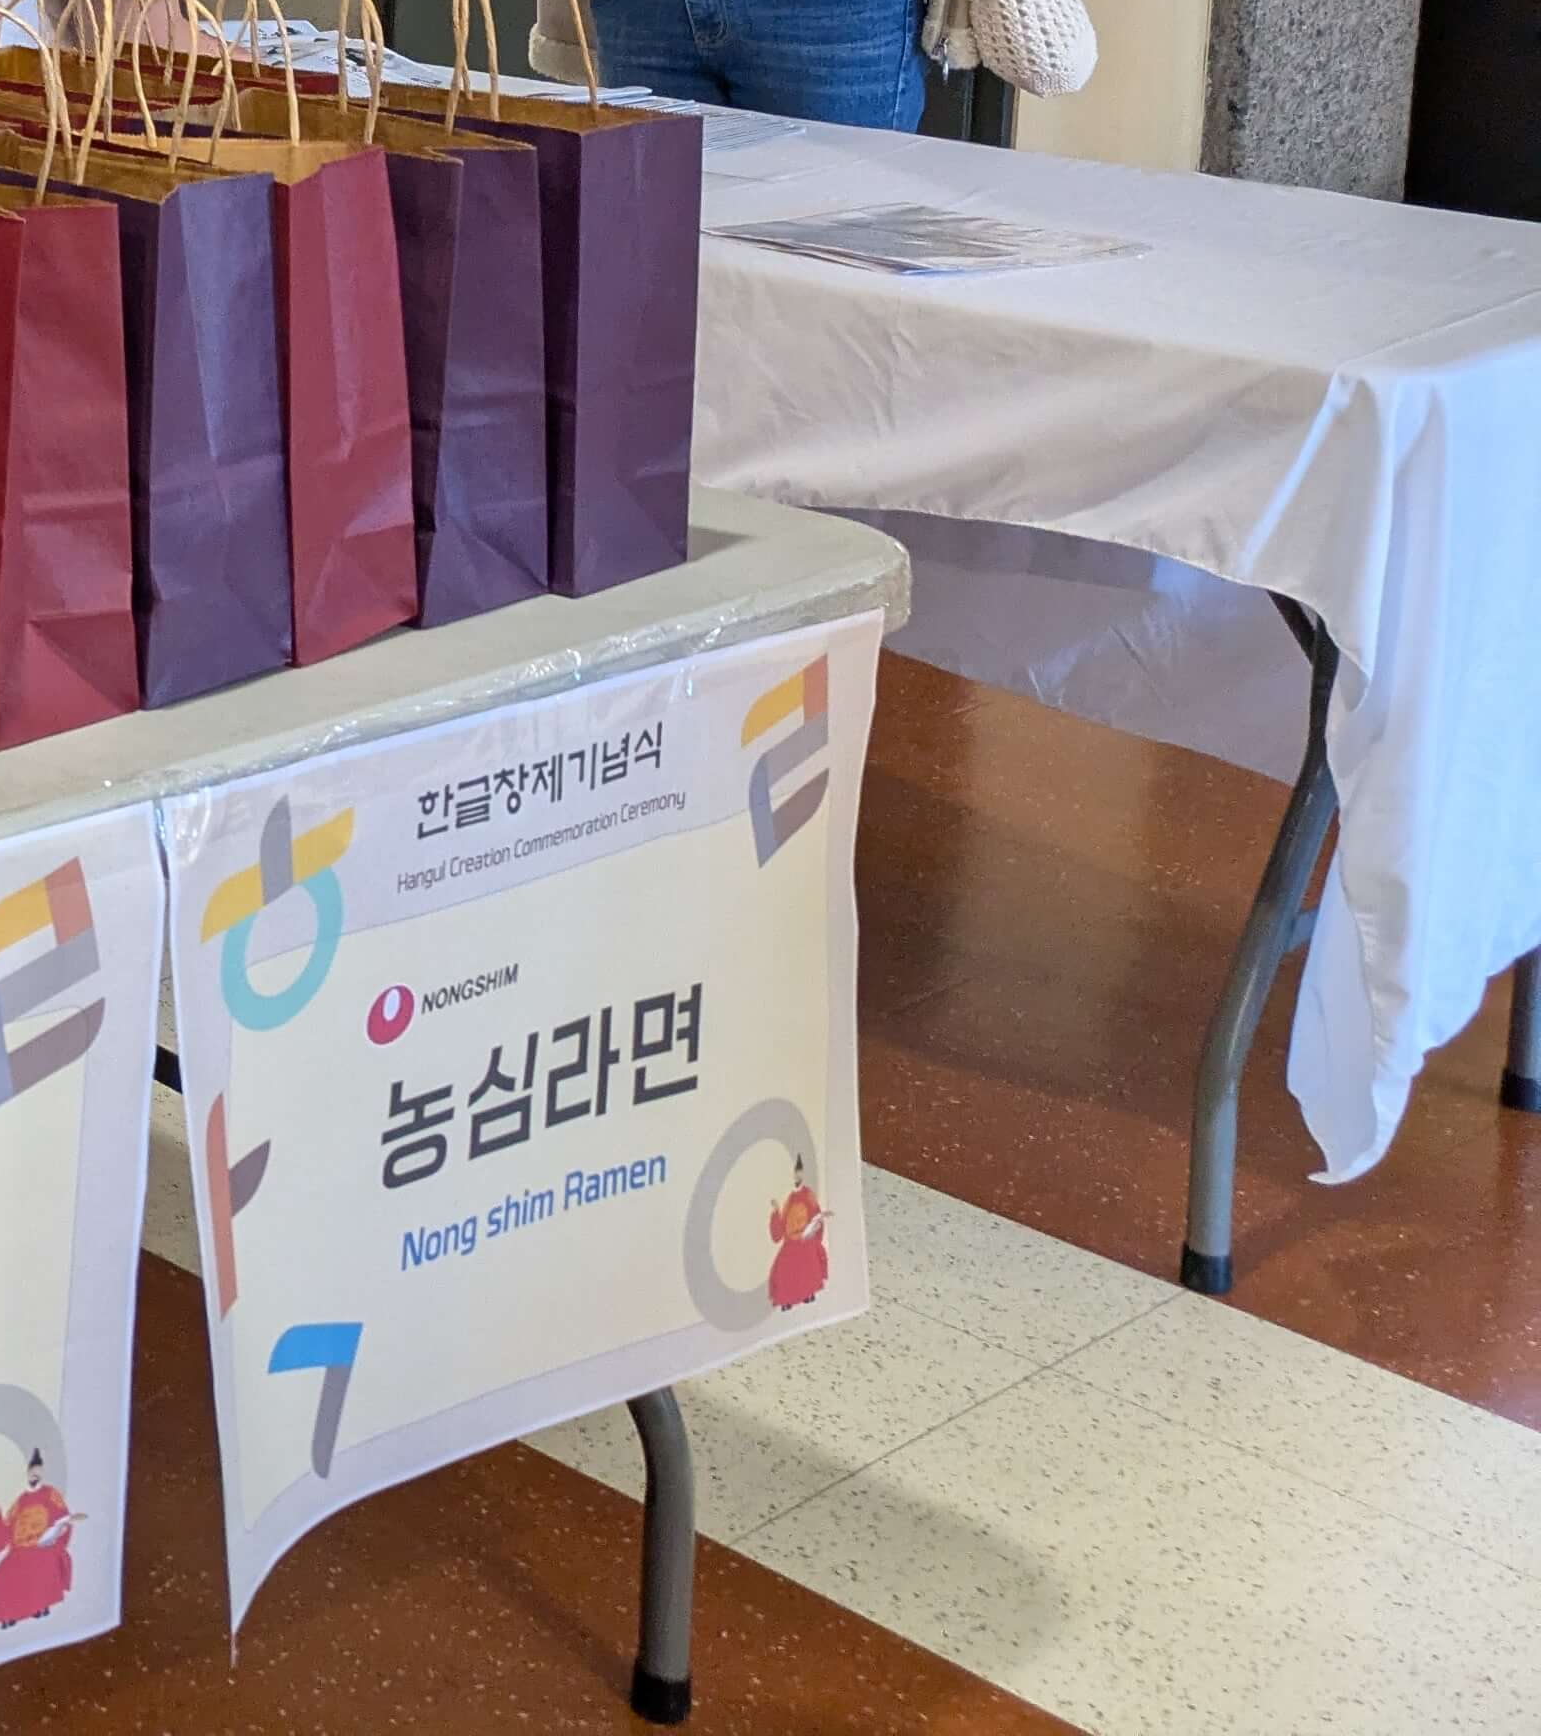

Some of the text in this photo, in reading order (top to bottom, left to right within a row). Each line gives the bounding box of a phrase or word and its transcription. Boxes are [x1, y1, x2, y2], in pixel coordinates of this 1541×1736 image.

[417, 721, 663, 840] 한글창제기념식
[397, 791, 686, 894] Hangul Creation Commemoration Ceremony
[421, 963, 519, 1015] NONGSHIM
[381, 982, 702, 1190] 농심라면
[401, 1155, 666, 1272] Nong shim Ramen
